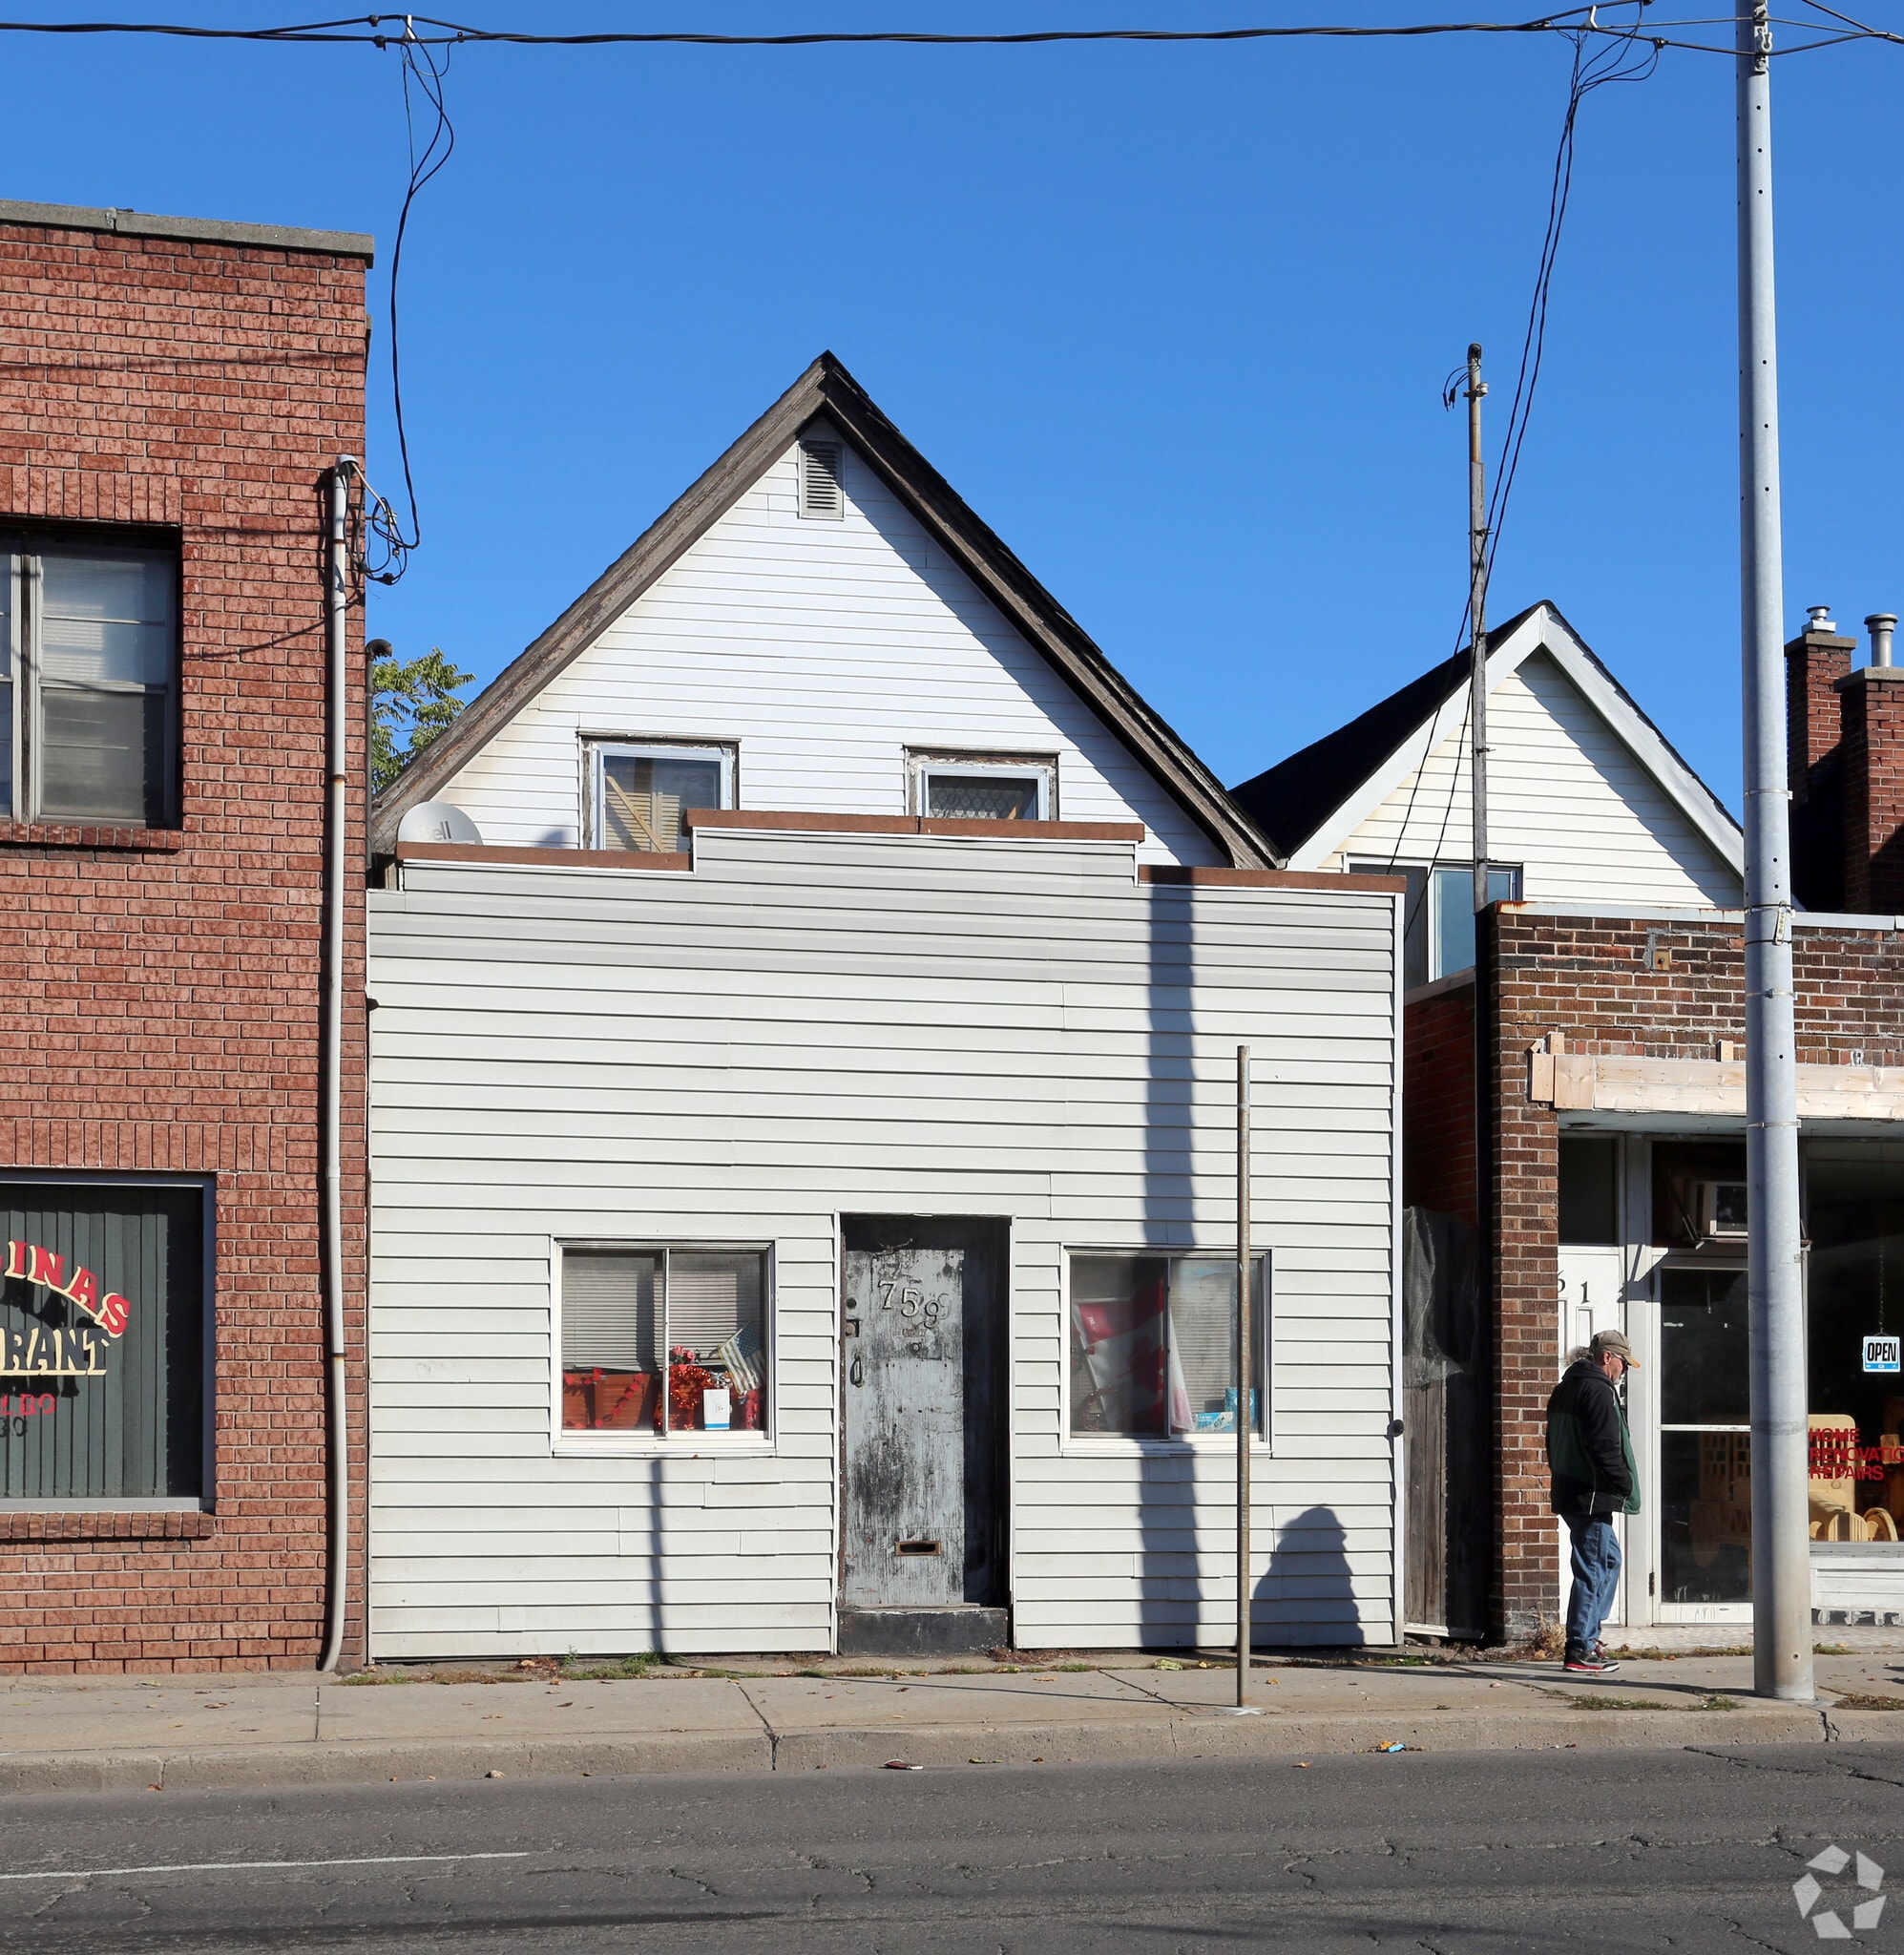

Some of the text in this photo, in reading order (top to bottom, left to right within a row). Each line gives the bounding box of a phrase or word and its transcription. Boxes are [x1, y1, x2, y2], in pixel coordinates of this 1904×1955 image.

[0, 1240, 130, 1338] INAS
[877, 1280, 940, 1329] 759
[1867, 1342, 1896, 1362] OPEN
[1809, 1427, 1861, 1442] HOME
[1809, 1446, 1904, 1462] RENOVATIO
[1810, 1465, 1885, 1481] REPAIRS
